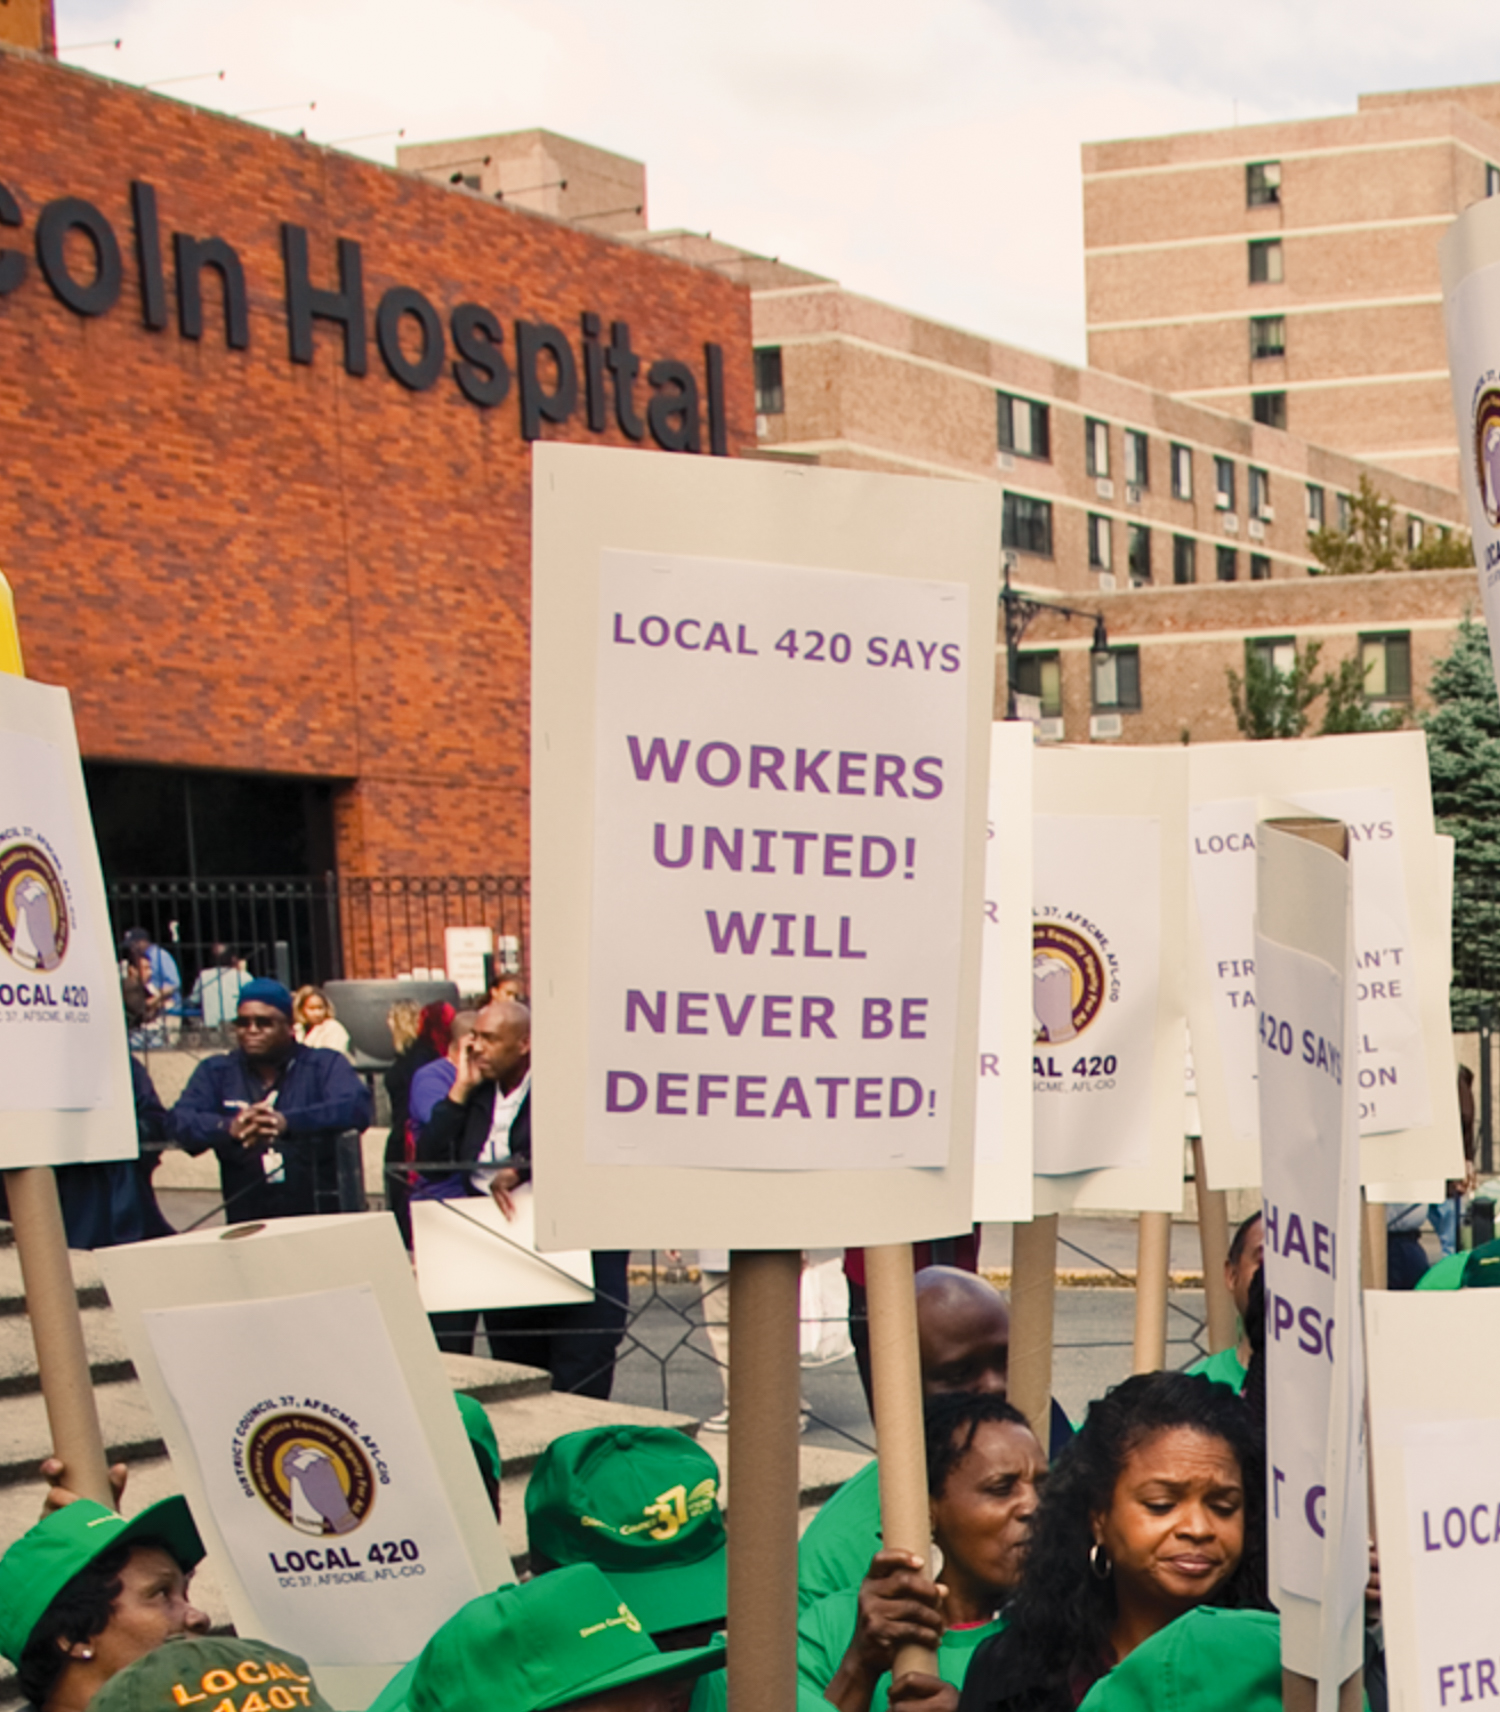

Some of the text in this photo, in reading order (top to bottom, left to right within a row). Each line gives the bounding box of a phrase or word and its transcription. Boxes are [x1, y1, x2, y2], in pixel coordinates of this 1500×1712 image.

[282, 223, 726, 457] Hospital
[612, 613, 962, 673] LOCAL 420 SAYS
[626, 734, 945, 801] WORKERS
[653, 823, 918, 881] UNITED!
[705, 909, 868, 959] WILL
[62, 985, 88, 1008] 420
[624, 988, 930, 1040] NEVER BE
[1072, 1055, 1117, 1077] 420
[604, 1070, 937, 1120] DEFEATED!
[360, 1435, 391, 1485] AFL-CIO
[643, 1483, 689, 1542] 37
[269, 1539, 419, 1574] LOCAL 420
[278, 1577, 297, 1588] DC
[318, 1570, 372, 1586] AFSCME,
[373, 1564, 426, 1580] AFL-CIO
[171, 1659, 311, 1706] LOCAL
